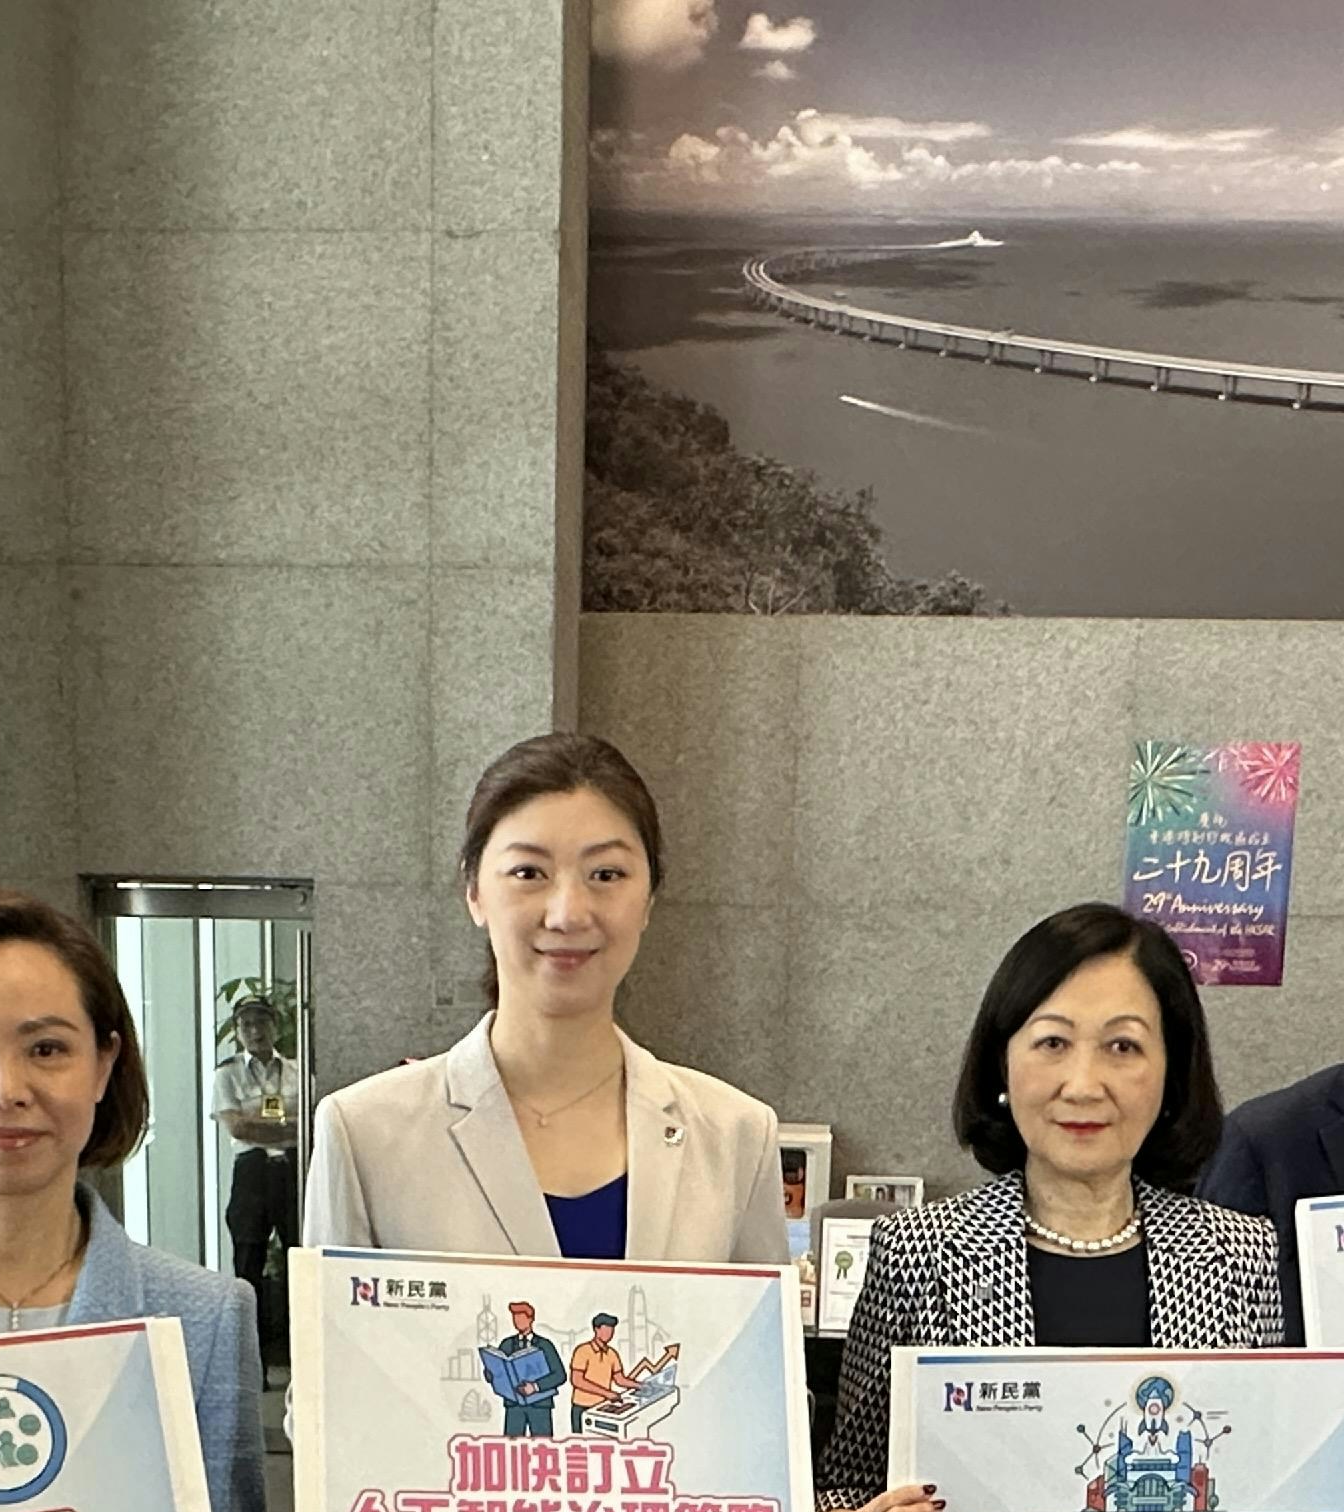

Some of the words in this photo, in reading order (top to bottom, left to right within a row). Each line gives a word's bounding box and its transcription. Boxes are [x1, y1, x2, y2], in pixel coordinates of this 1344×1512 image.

[1132, 848, 1282, 892] 二十九周年
[1170, 894, 1264, 921] Anniversary
[386, 1278, 448, 1299] 新民黨
[978, 1381, 1042, 1400] 新民黨
[455, 1440, 670, 1495] 加快訂立
